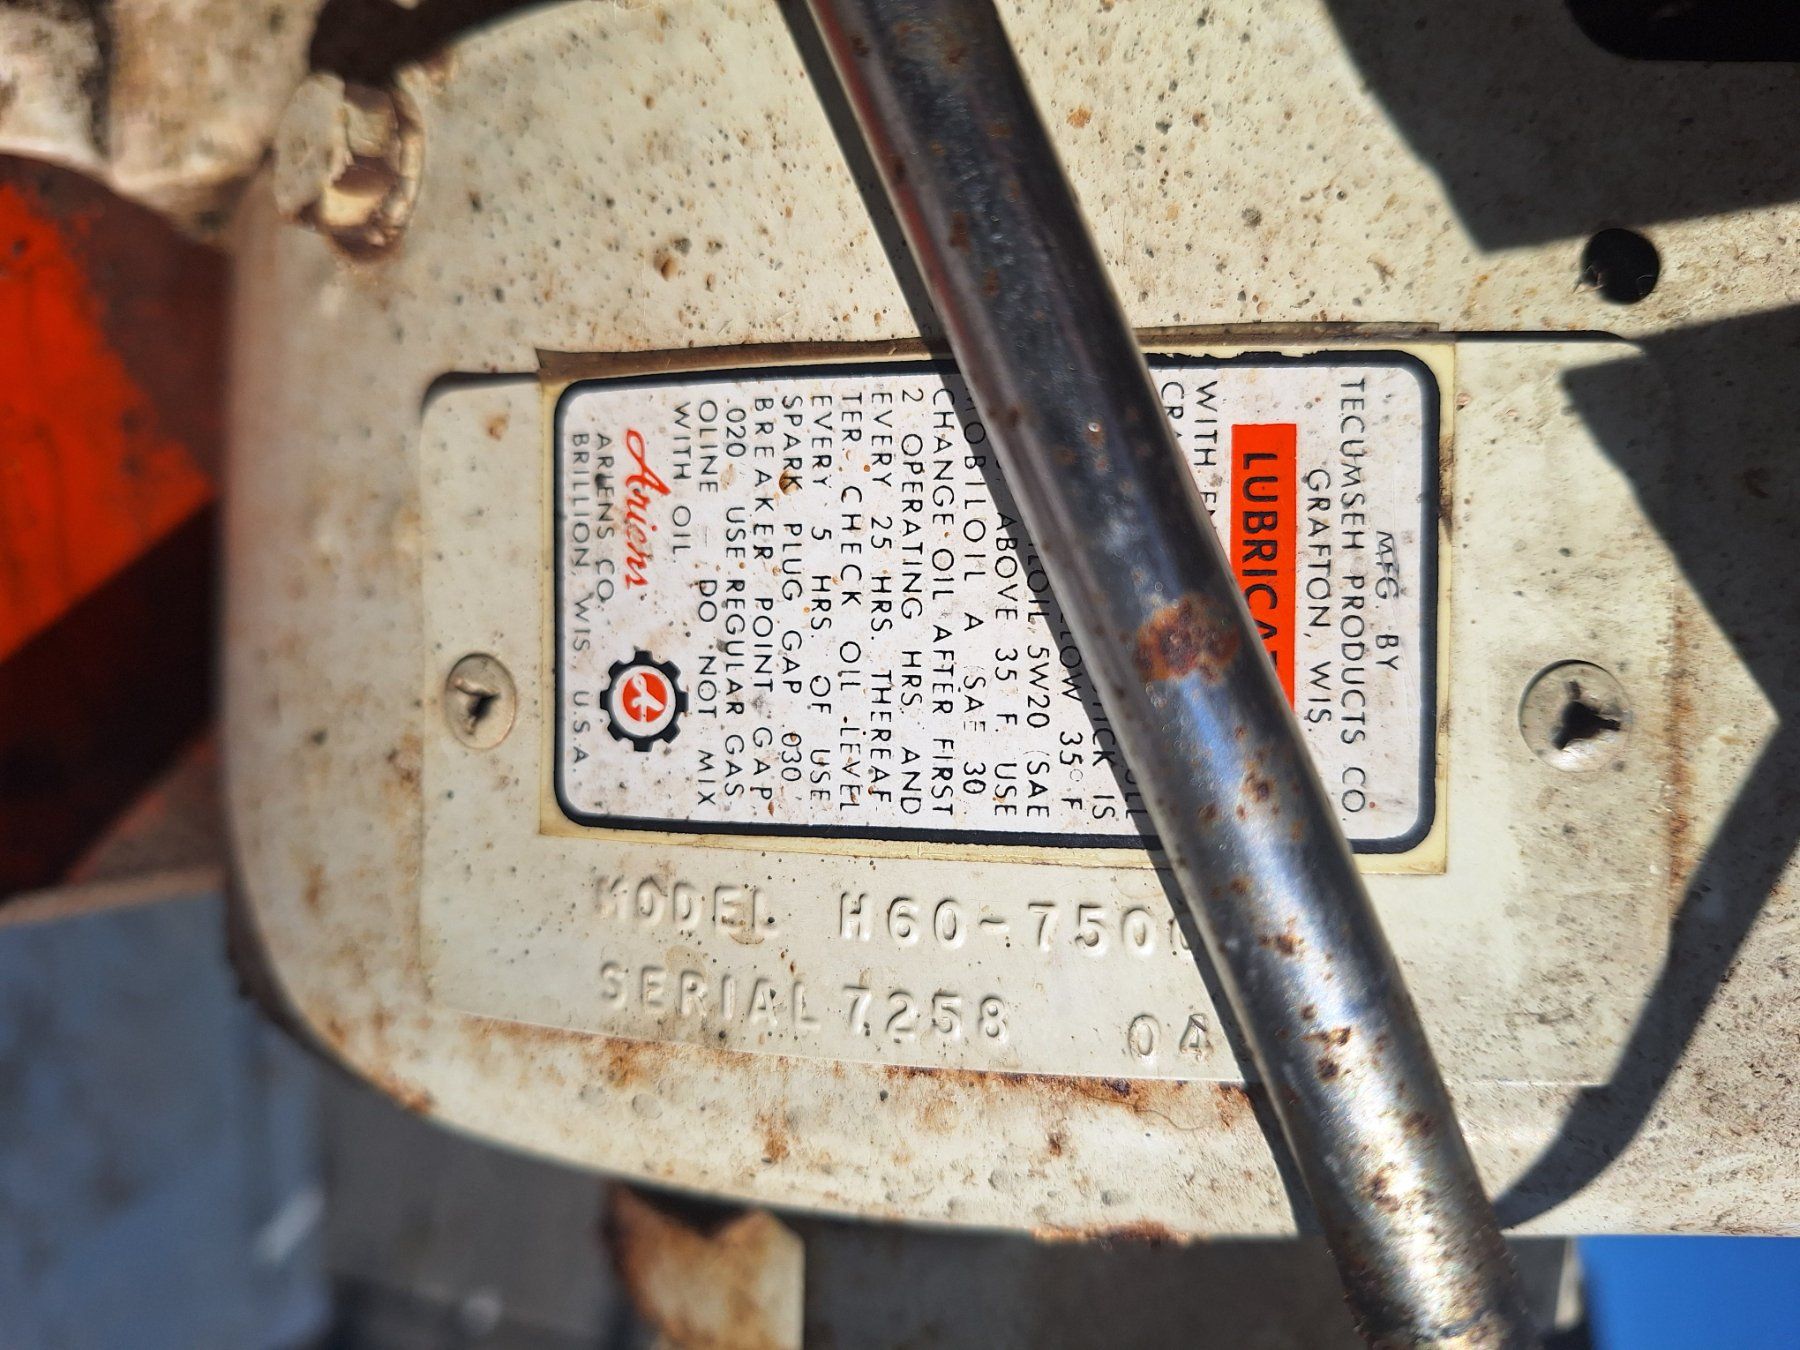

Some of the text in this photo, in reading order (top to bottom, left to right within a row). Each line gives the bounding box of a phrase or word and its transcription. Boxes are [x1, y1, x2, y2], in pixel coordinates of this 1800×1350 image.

[781, 395, 803, 490] SPARK
[811, 395, 833, 489] EVERY
[871, 392, 893, 488] EVERY
[1194, 380, 1218, 467] WITH
[596, 432, 615, 540] ARIENS
[622, 428, 672, 591] Ariens
[671, 401, 692, 563] WITH OIL.
[725, 506, 746, 558] USE
[781, 523, 803, 601] PLUG
[811, 525, 832, 541] 5
[870, 516, 893, 549] 25
[994, 512, 1019, 621] ABOVE
[1242, 452, 1279, 671] LUBRICA
[697, 399, 718, 806] OLINE DO NOT MIX
[752, 397, 775, 800] BREAKER POINT GAP
[810, 575, 833, 638] HRS.
[839, 392, 863, 811] TER. CHECK OIL LEVEL
[870, 576, 893, 640] HRS.
[900, 388, 924, 815] 2 OPERATING HRS. AND
[930, 387, 955, 816] CHANGE OIL AFTER FIRST
[964, 611, 985, 632] A
[1303, 468, 1332, 732] GRAFTON, WIS.
[1340, 378, 1366, 821] TECUMSEH PRODUCTS CO.
[725, 579, 746, 715] REGULAR
[781, 629, 803, 694] GAP
[994, 648, 1019, 681] 35
[1026, 645, 1051, 728] 5W20
[1059, 612, 1083, 702] LOW
[1375, 633, 1399, 671] BY
[572, 690, 591, 773] U.S.A.
[809, 674, 832, 715] OF
[994, 762, 1018, 817] USE
[1091, 794, 1116, 820] IS
[596, 874, 777, 935] MODEL
[600, 961, 820, 1030] SERIAL
[843, 983, 1010, 1045] 7258
